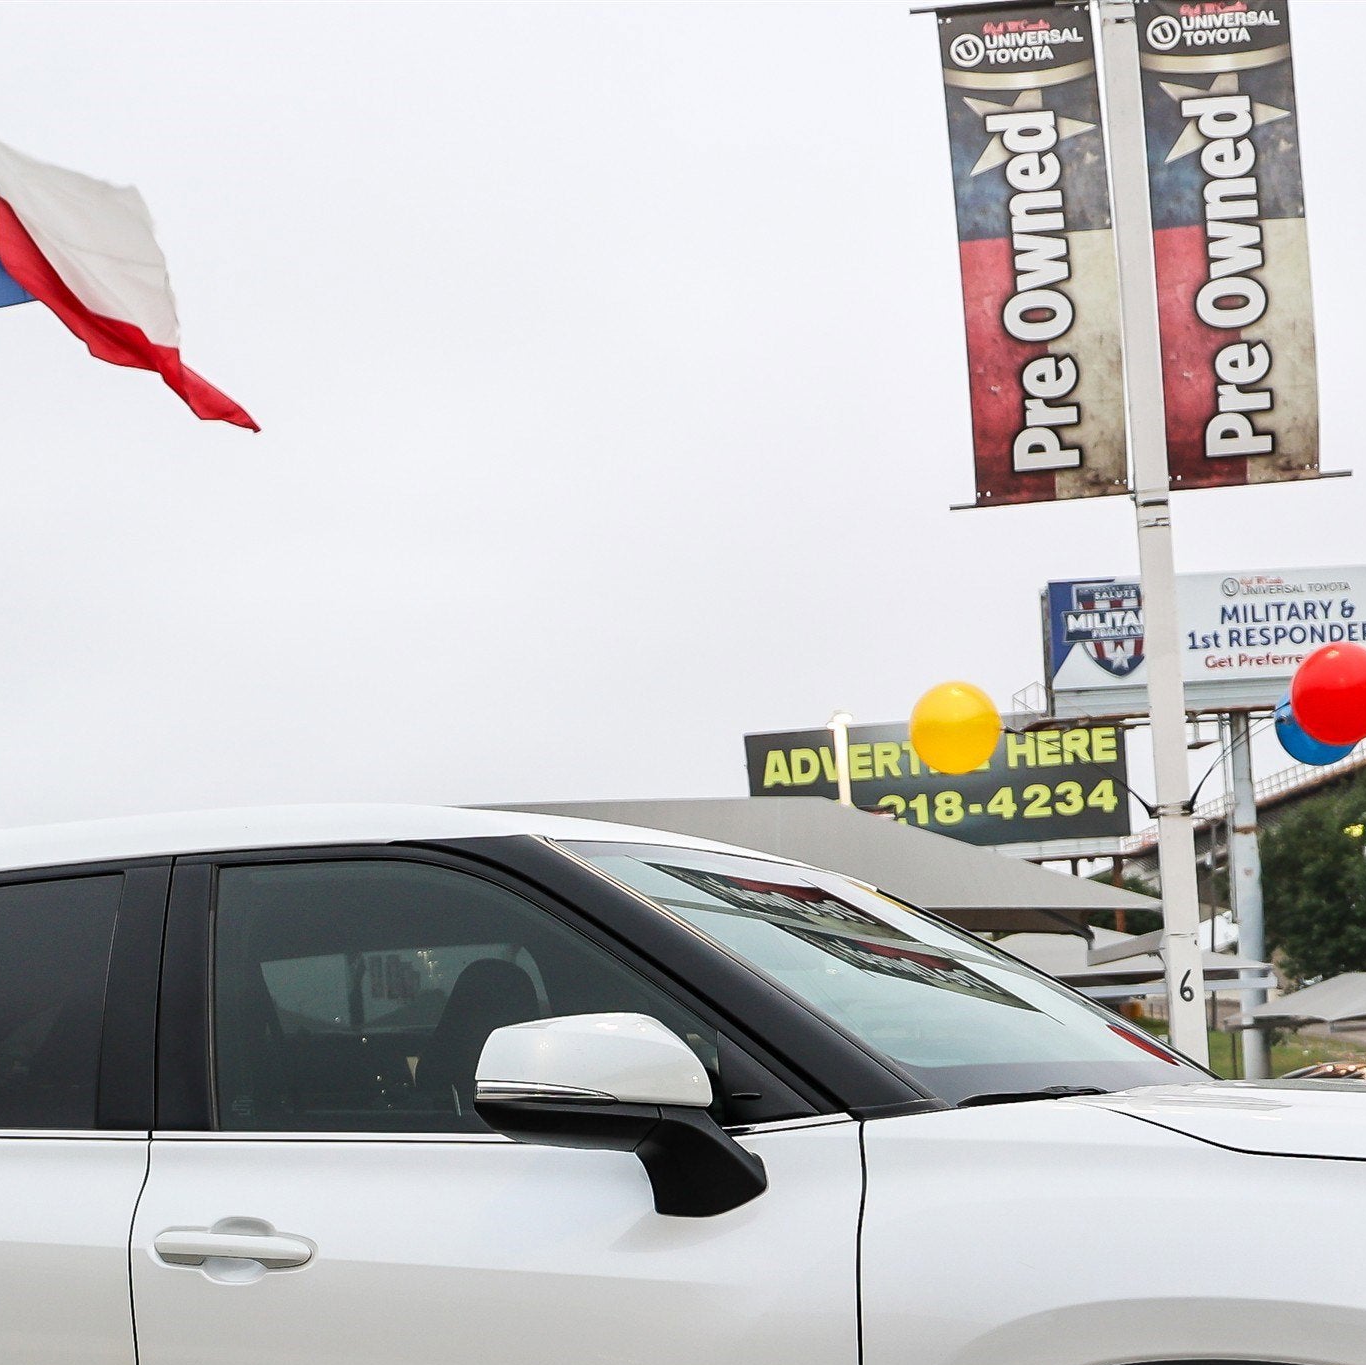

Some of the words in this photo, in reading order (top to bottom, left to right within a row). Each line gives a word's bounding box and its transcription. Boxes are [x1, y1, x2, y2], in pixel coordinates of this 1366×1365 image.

[1181, 10, 1280, 30] UNIVERSAL
[985, 27, 1084, 48] UNIVERSAL
[1182, 27, 1251, 46] TOYOTA
[986, 46, 1054, 64] TOYOTA
[1182, 95, 1267, 328] Owned
[986, 110, 1074, 342] Owned
[1205, 342, 1273, 458] Pre
[1014, 355, 1082, 472] Pre
[1242, 583, 1305, 596] UNIVERSAL
[1067, 609, 1144, 633] MILITA
[1221, 599, 1334, 624] MILITARY
[1340, 598, 1355, 618] &
[1188, 630, 1221, 650] 1st
[1205, 653, 1233, 669] Get
[1239, 652, 1304, 668] Preferre
[763, 738, 991, 789] ADVERT
[1006, 727, 1118, 768] HERE
[1180, 969, 1194, 1002] 6
